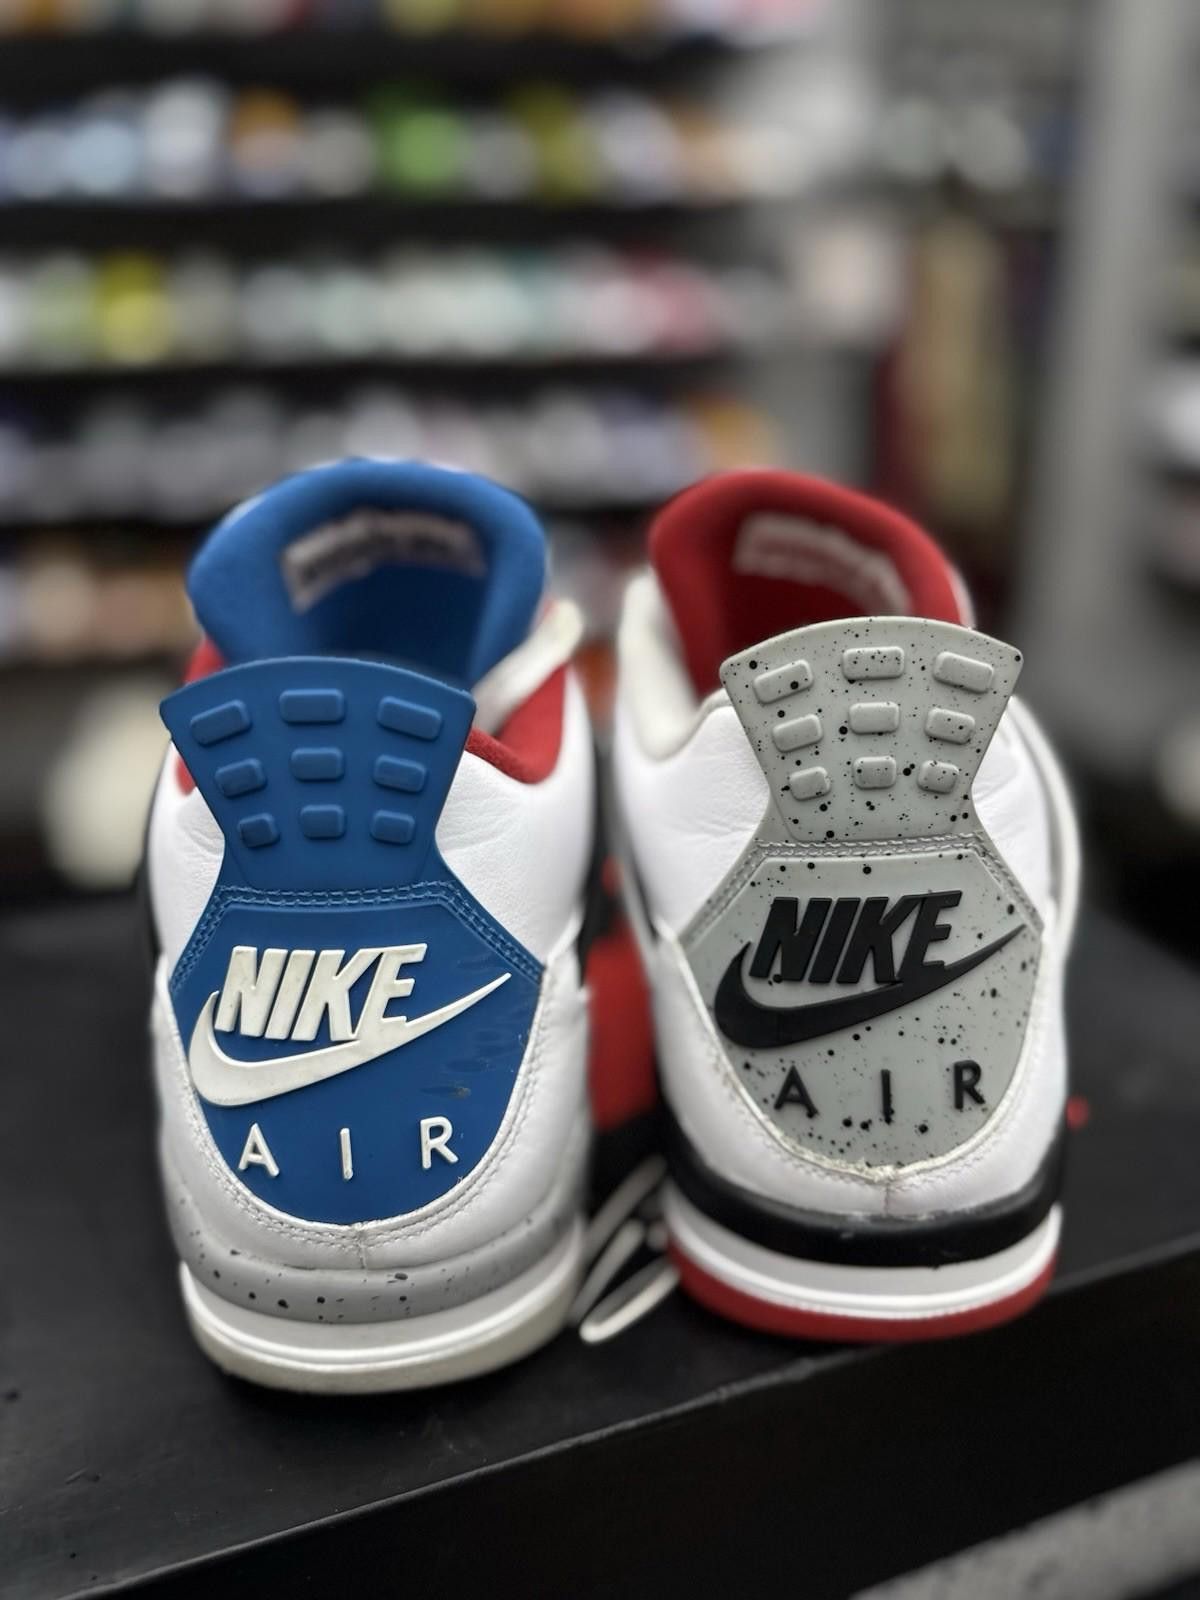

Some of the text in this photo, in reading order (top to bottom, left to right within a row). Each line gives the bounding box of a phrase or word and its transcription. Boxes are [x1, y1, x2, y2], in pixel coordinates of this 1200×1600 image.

[748, 889, 962, 984] NIKE
[214, 943, 428, 1042] NIKE
[773, 1059, 986, 1125] AIR
[237, 1115, 459, 1181] AIR
